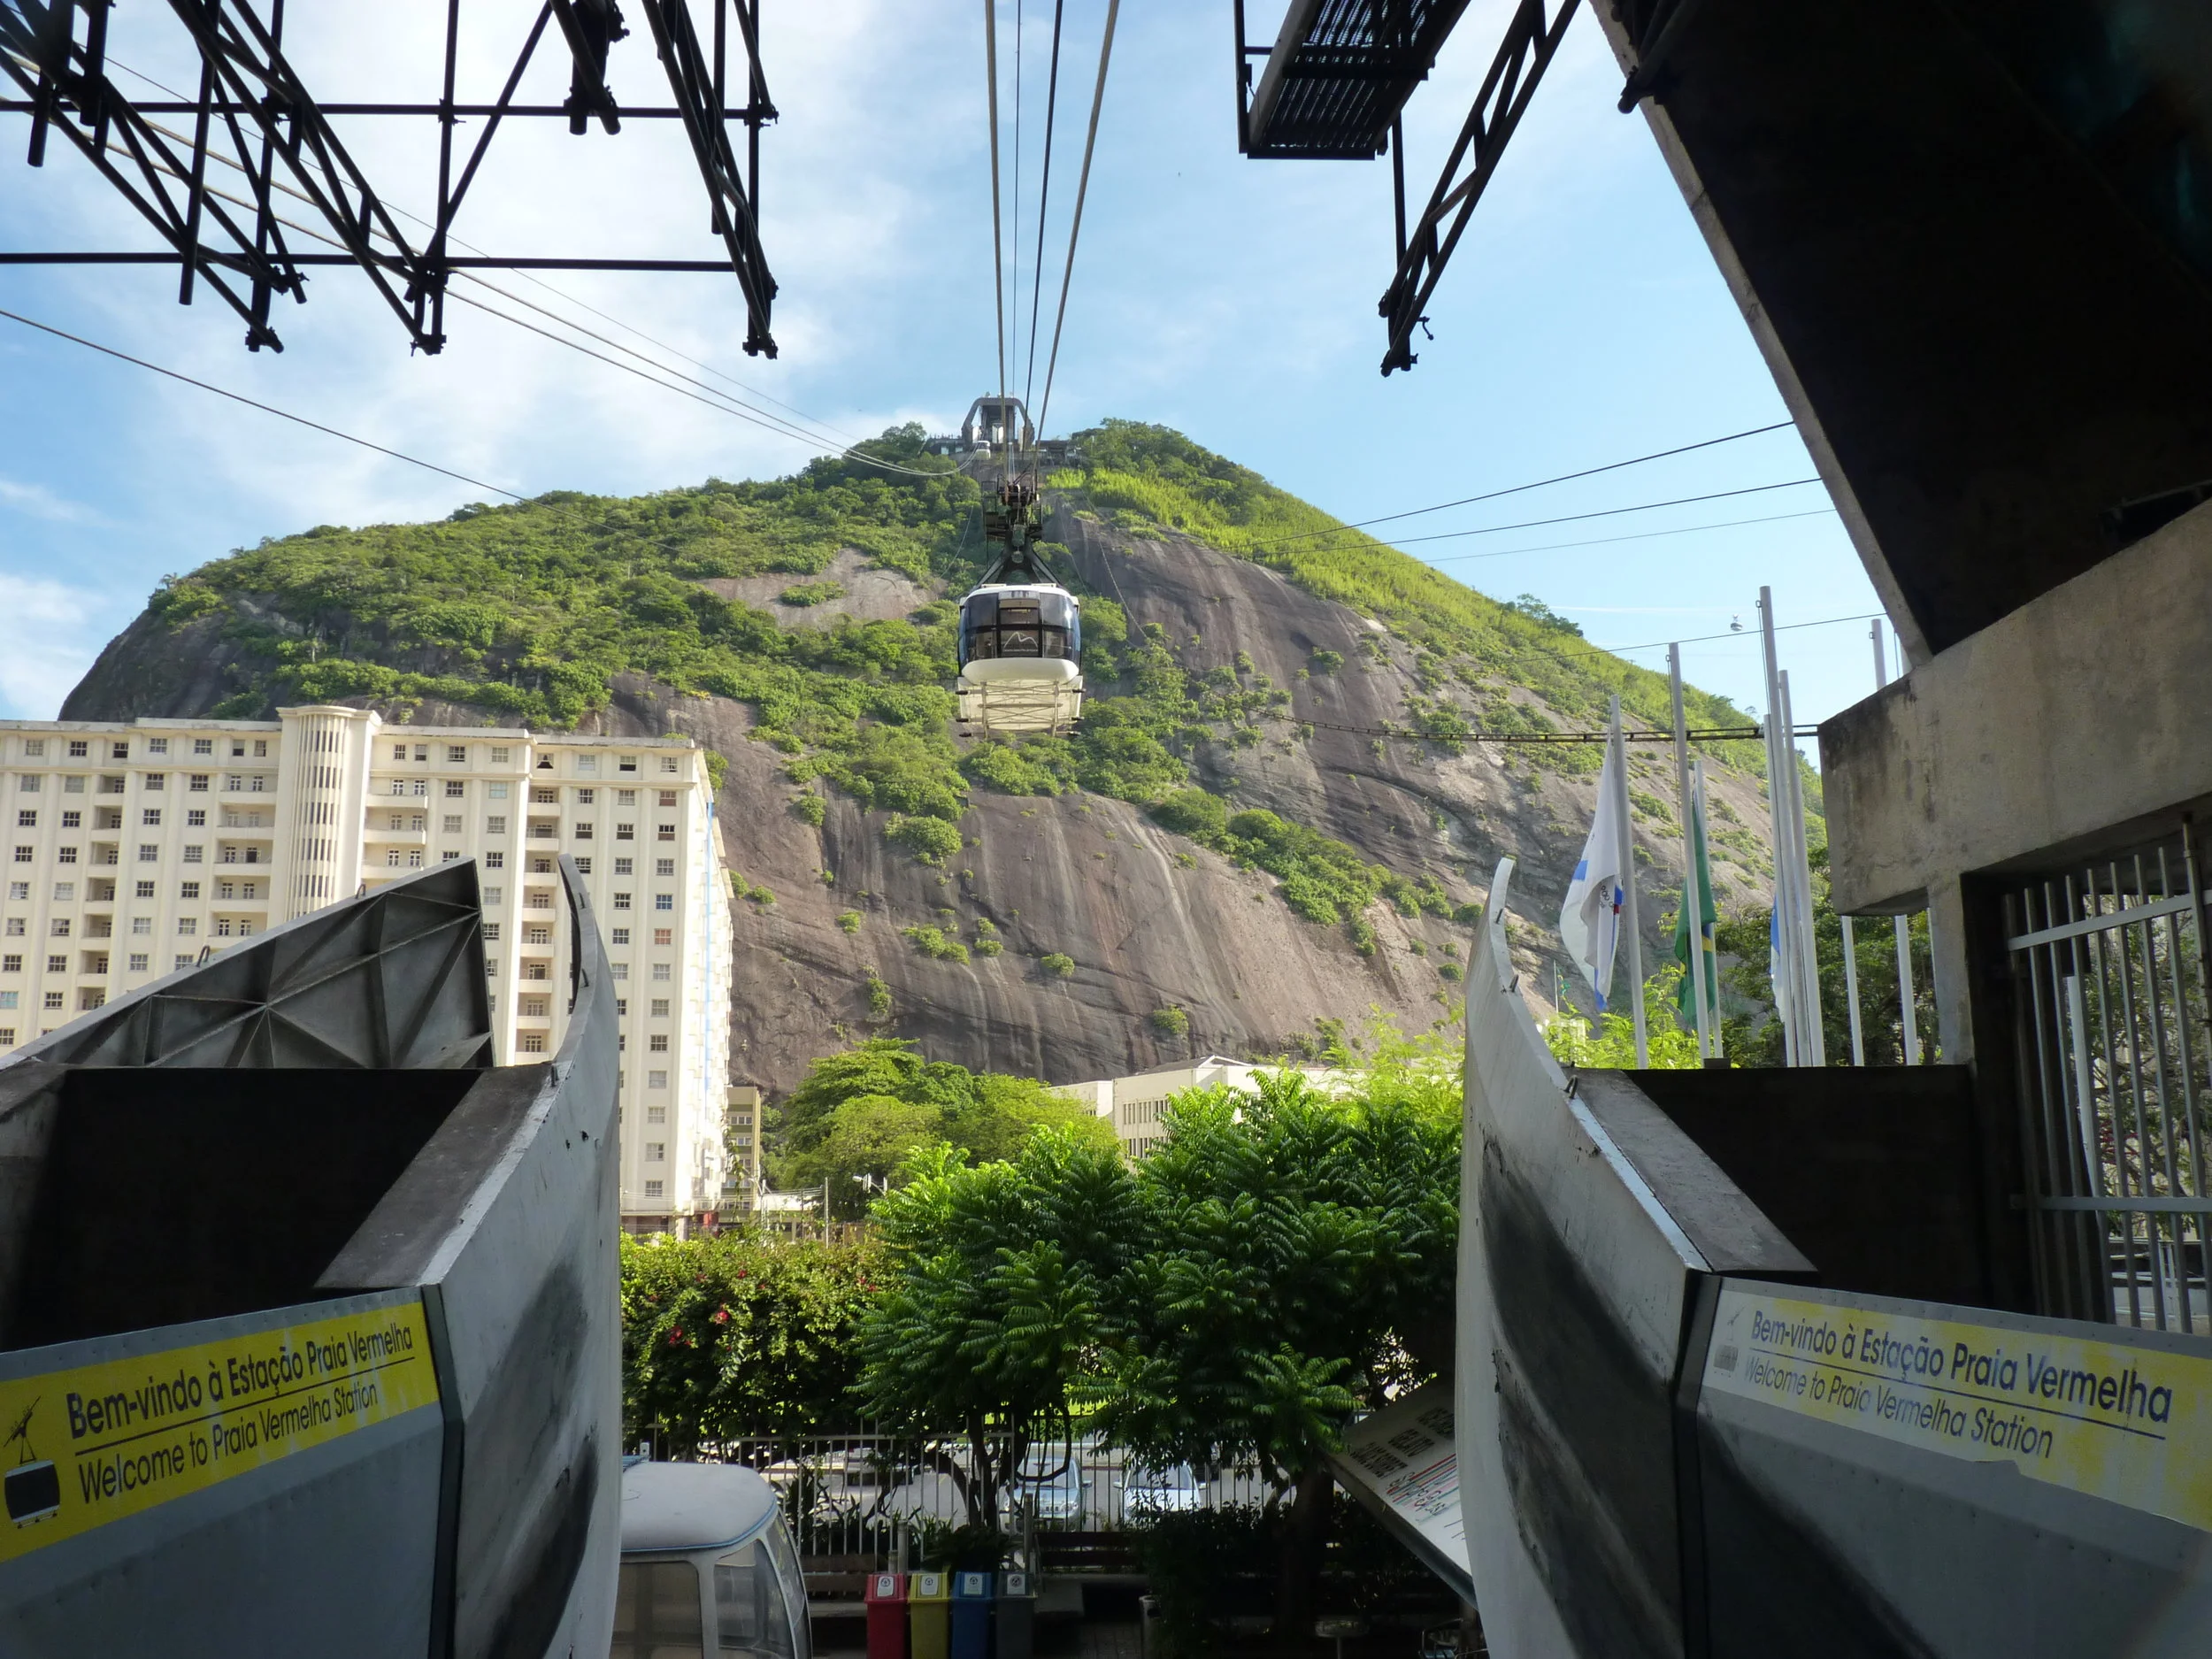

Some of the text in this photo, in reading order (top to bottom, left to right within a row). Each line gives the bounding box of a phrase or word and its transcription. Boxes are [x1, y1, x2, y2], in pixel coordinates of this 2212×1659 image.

[65, 1322, 413, 1440] Bem-vindo à Estação Praia Vermelha
[1744, 1356, 2054, 1459] Welcome to Praia Vermelha Station
[1751, 1310, 2173, 1424] Bem-vindo à Estação Praia Vermelha
[78, 1380, 379, 1504] Welcome to Praia Vermelha Station
